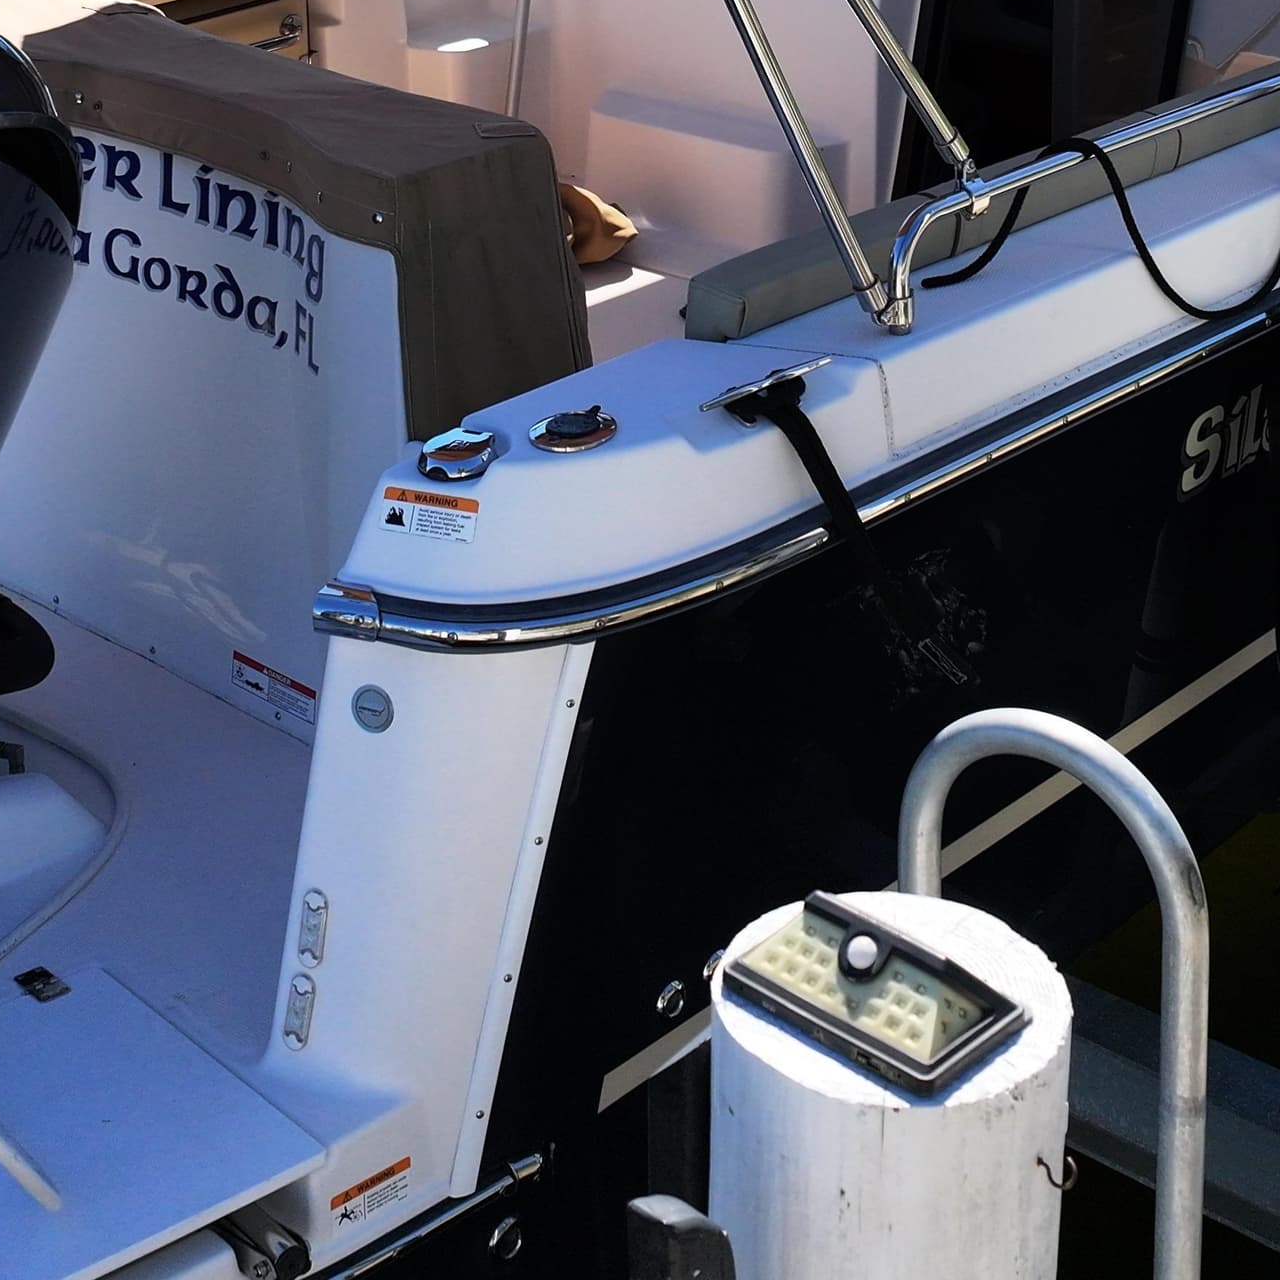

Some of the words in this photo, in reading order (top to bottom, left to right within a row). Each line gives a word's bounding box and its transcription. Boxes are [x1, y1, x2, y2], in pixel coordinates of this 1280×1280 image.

[160, 152, 325, 304] Lining
[104, 228, 289, 349] Gorda,
[295, 299, 320, 376] FL
[414, 493, 459, 509] WARNING
[357, 1166, 396, 1194] WARNING
